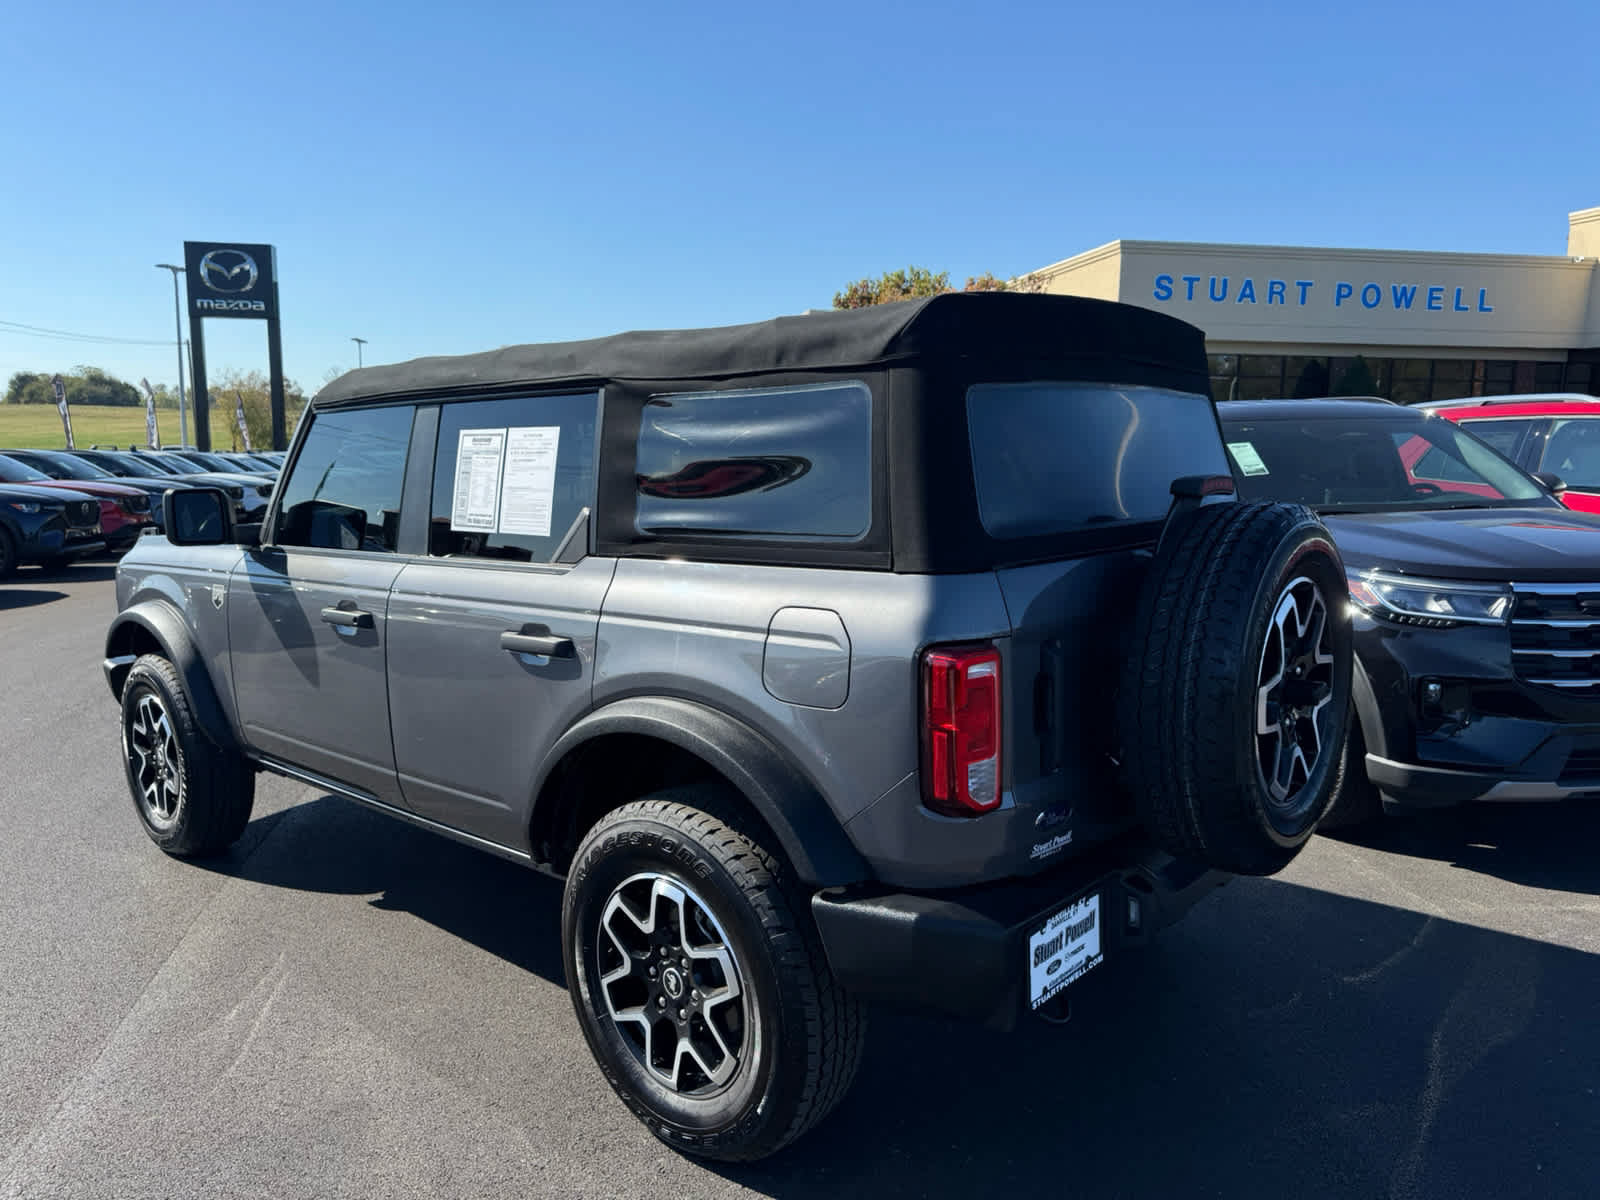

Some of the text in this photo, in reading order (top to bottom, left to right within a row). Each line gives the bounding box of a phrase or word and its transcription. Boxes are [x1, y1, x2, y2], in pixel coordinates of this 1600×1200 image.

[196, 298, 265, 311] mazda
[1153, 274, 1494, 313] STUART POWELL
[1034, 929, 1064, 968] Stuart
[1064, 907, 1096, 947] Powell
